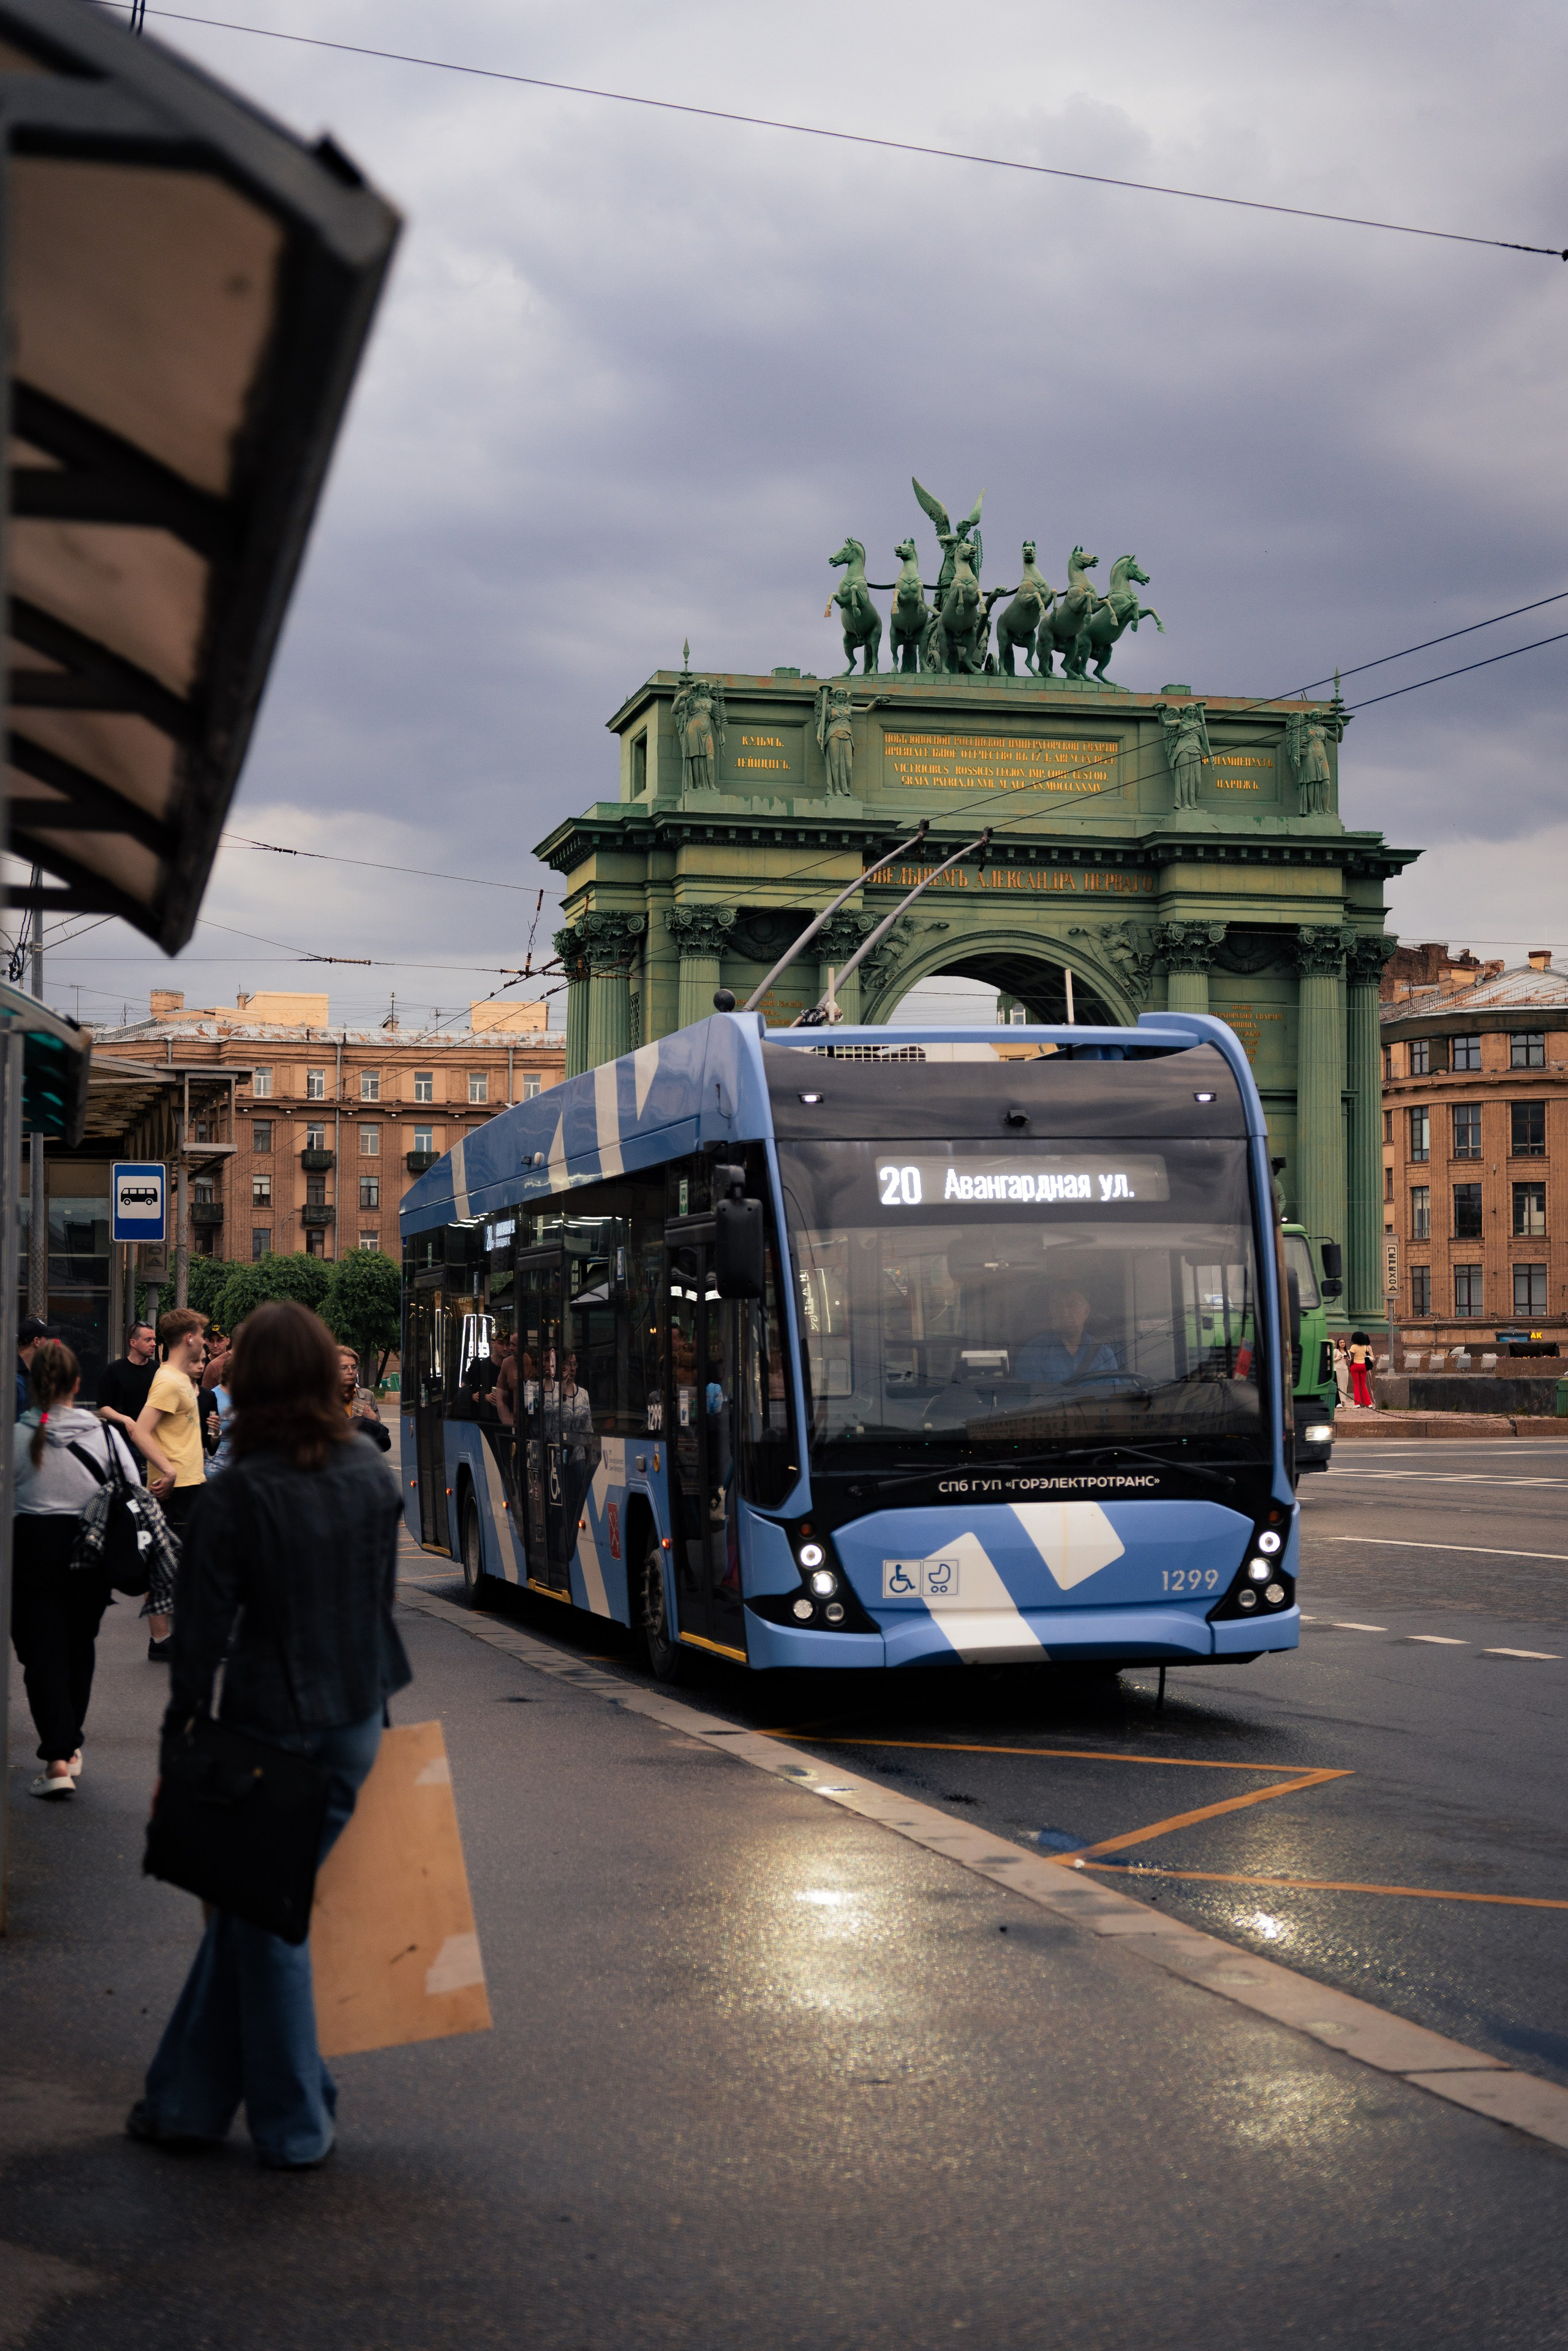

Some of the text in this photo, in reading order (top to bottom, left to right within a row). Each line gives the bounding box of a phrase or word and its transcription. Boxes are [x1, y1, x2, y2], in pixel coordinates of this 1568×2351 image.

[884, 747, 957, 758] ПРИЗНАТЕЛЬНОЕ
[961, 749, 1012, 761] ОТЕЧЕСТВО
[1031, 752, 1041, 761] 17
[1055, 753, 1091, 764] АВГУСТА
[894, 763, 949, 774] VICTRICIBUS
[956, 766, 993, 776] ROSSICIS
[1029, 768, 1046, 778] IMP.
[901, 775, 929, 785] GRATA
[974, 870, 1076, 891] АЛЕКСАНДРА
[880, 1166, 1134, 1205] 20 Авангардная ул.
[1388, 1247, 1397, 1291] ПЕРЕХОД
[647, 1405, 662, 1430] 1299
[972, 1479, 1001, 1490] ГУП
[1162, 1569, 1219, 1591] 1299
